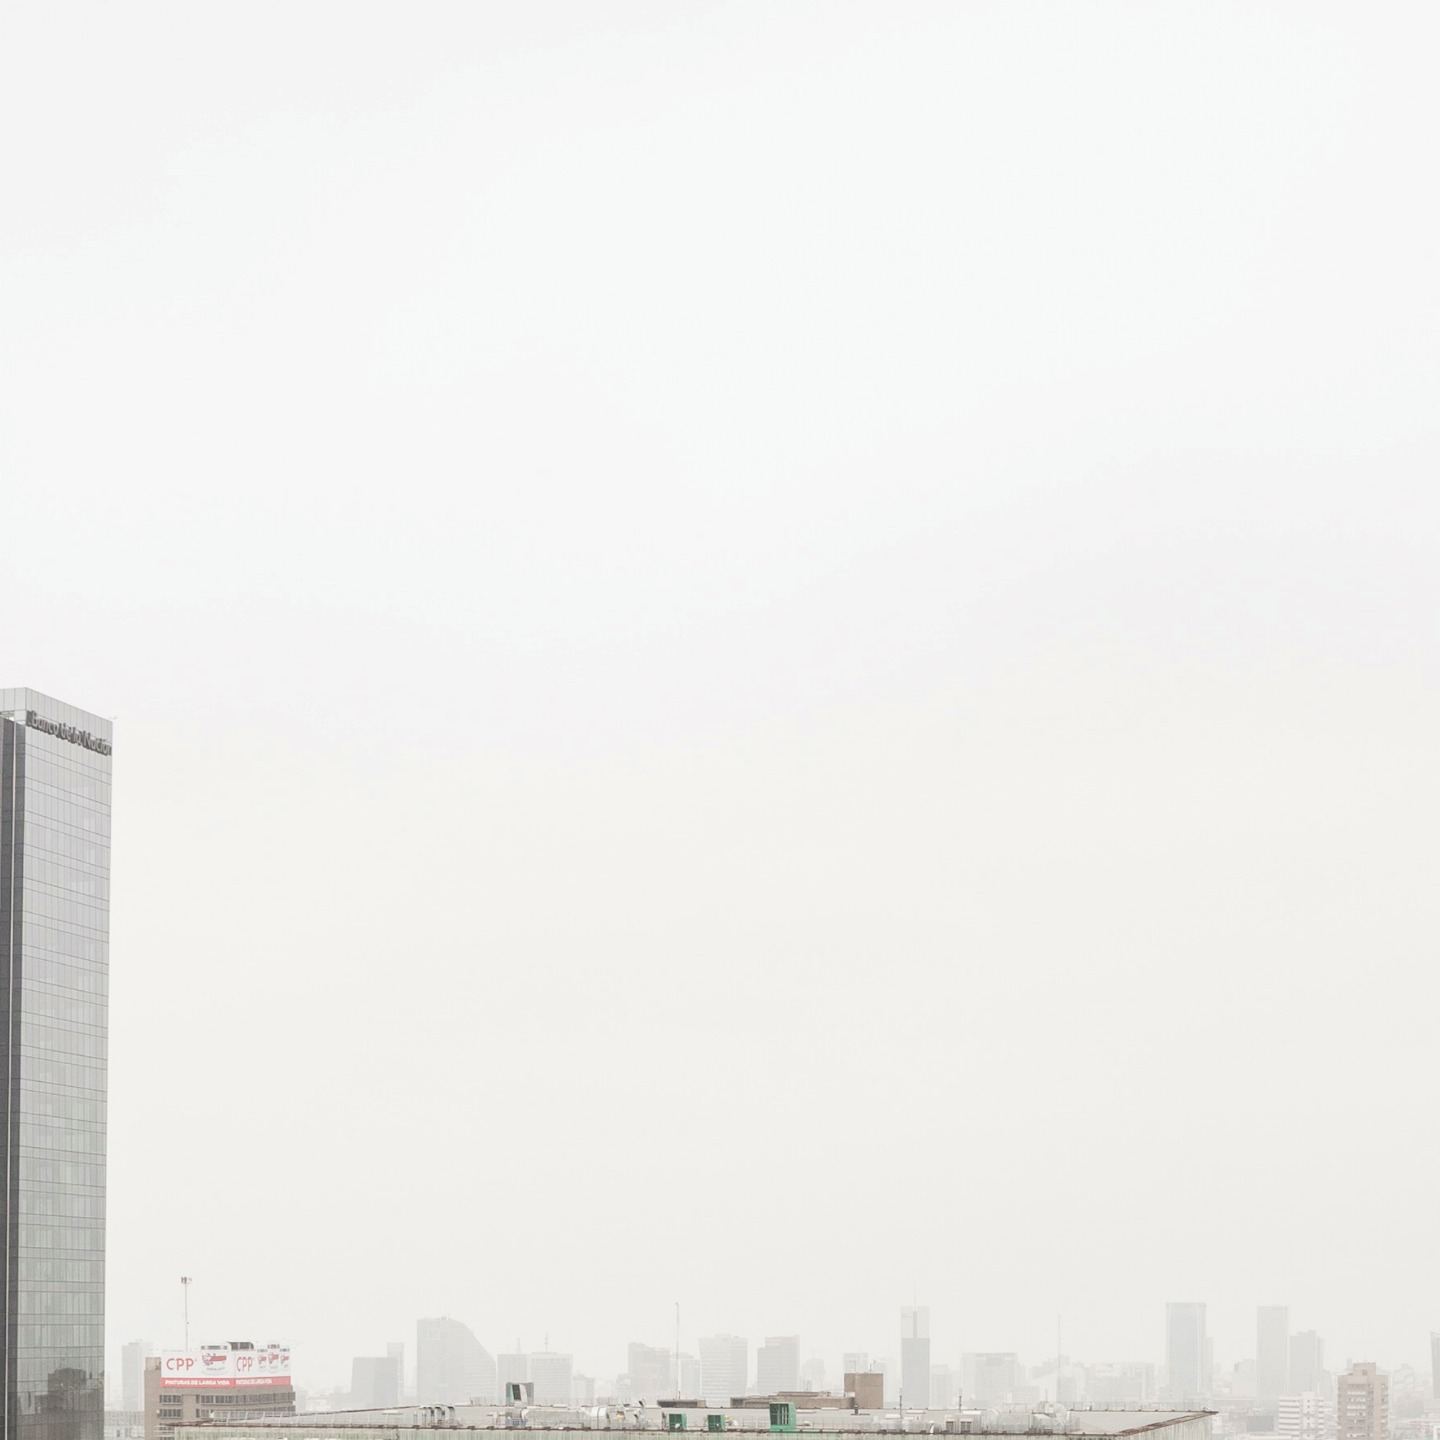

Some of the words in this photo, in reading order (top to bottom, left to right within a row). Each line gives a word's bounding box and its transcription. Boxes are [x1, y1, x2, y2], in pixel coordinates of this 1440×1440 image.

[27, 711, 59, 737] Banco
[166, 1358, 194, 1371] CPP
[237, 1356, 253, 1372] CPP
